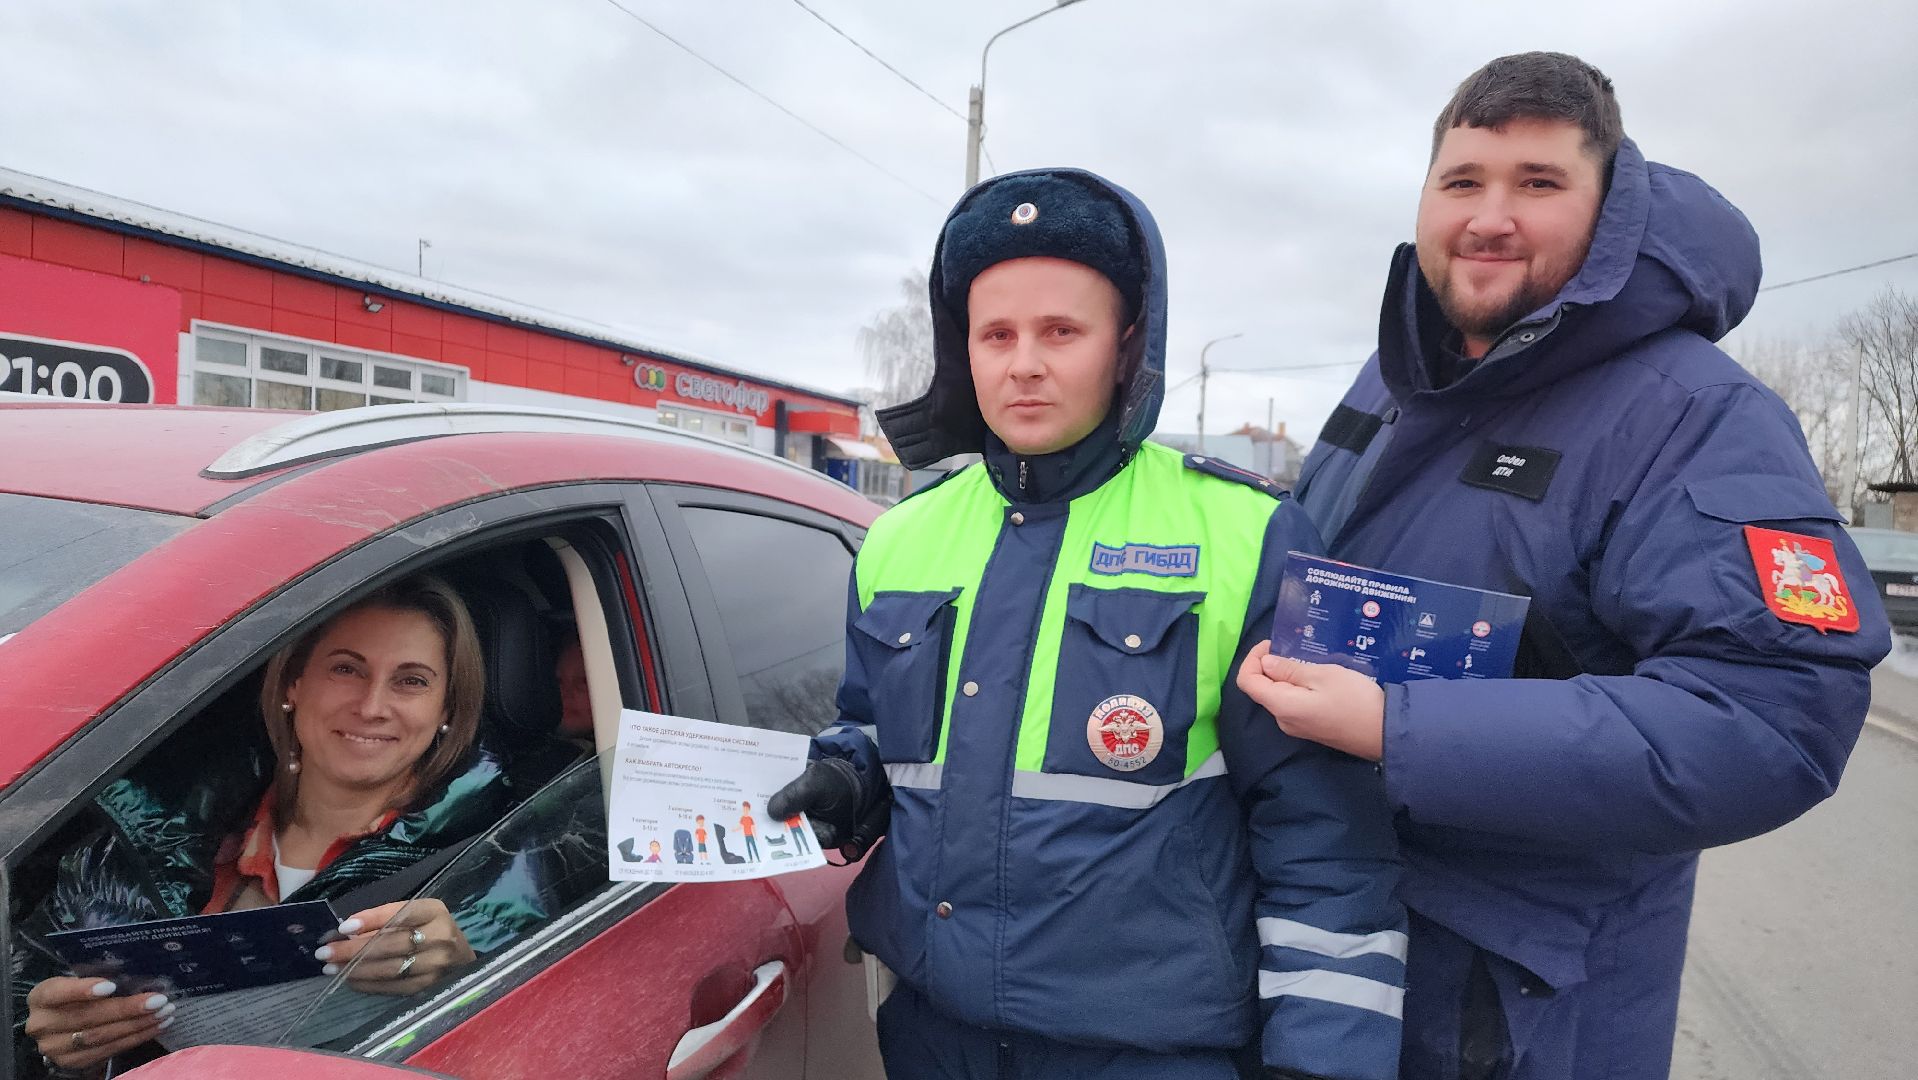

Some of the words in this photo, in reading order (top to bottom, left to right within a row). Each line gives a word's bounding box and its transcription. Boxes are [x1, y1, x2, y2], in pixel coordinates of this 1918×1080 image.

[1134, 550, 1192, 569] ГИБДД
[1305, 574, 1361, 592] ДОРОЖНОГО
[1361, 586, 1417, 604] ДВИЖЕНИЯ!
[1307, 567, 1369, 587] СОБЛЮДАЙТЕ
[1368, 580, 1410, 594] ПРАВИЛА
[1093, 697, 1154, 720] ПОЛИЯ
[1115, 743, 1140, 755] ДПС
